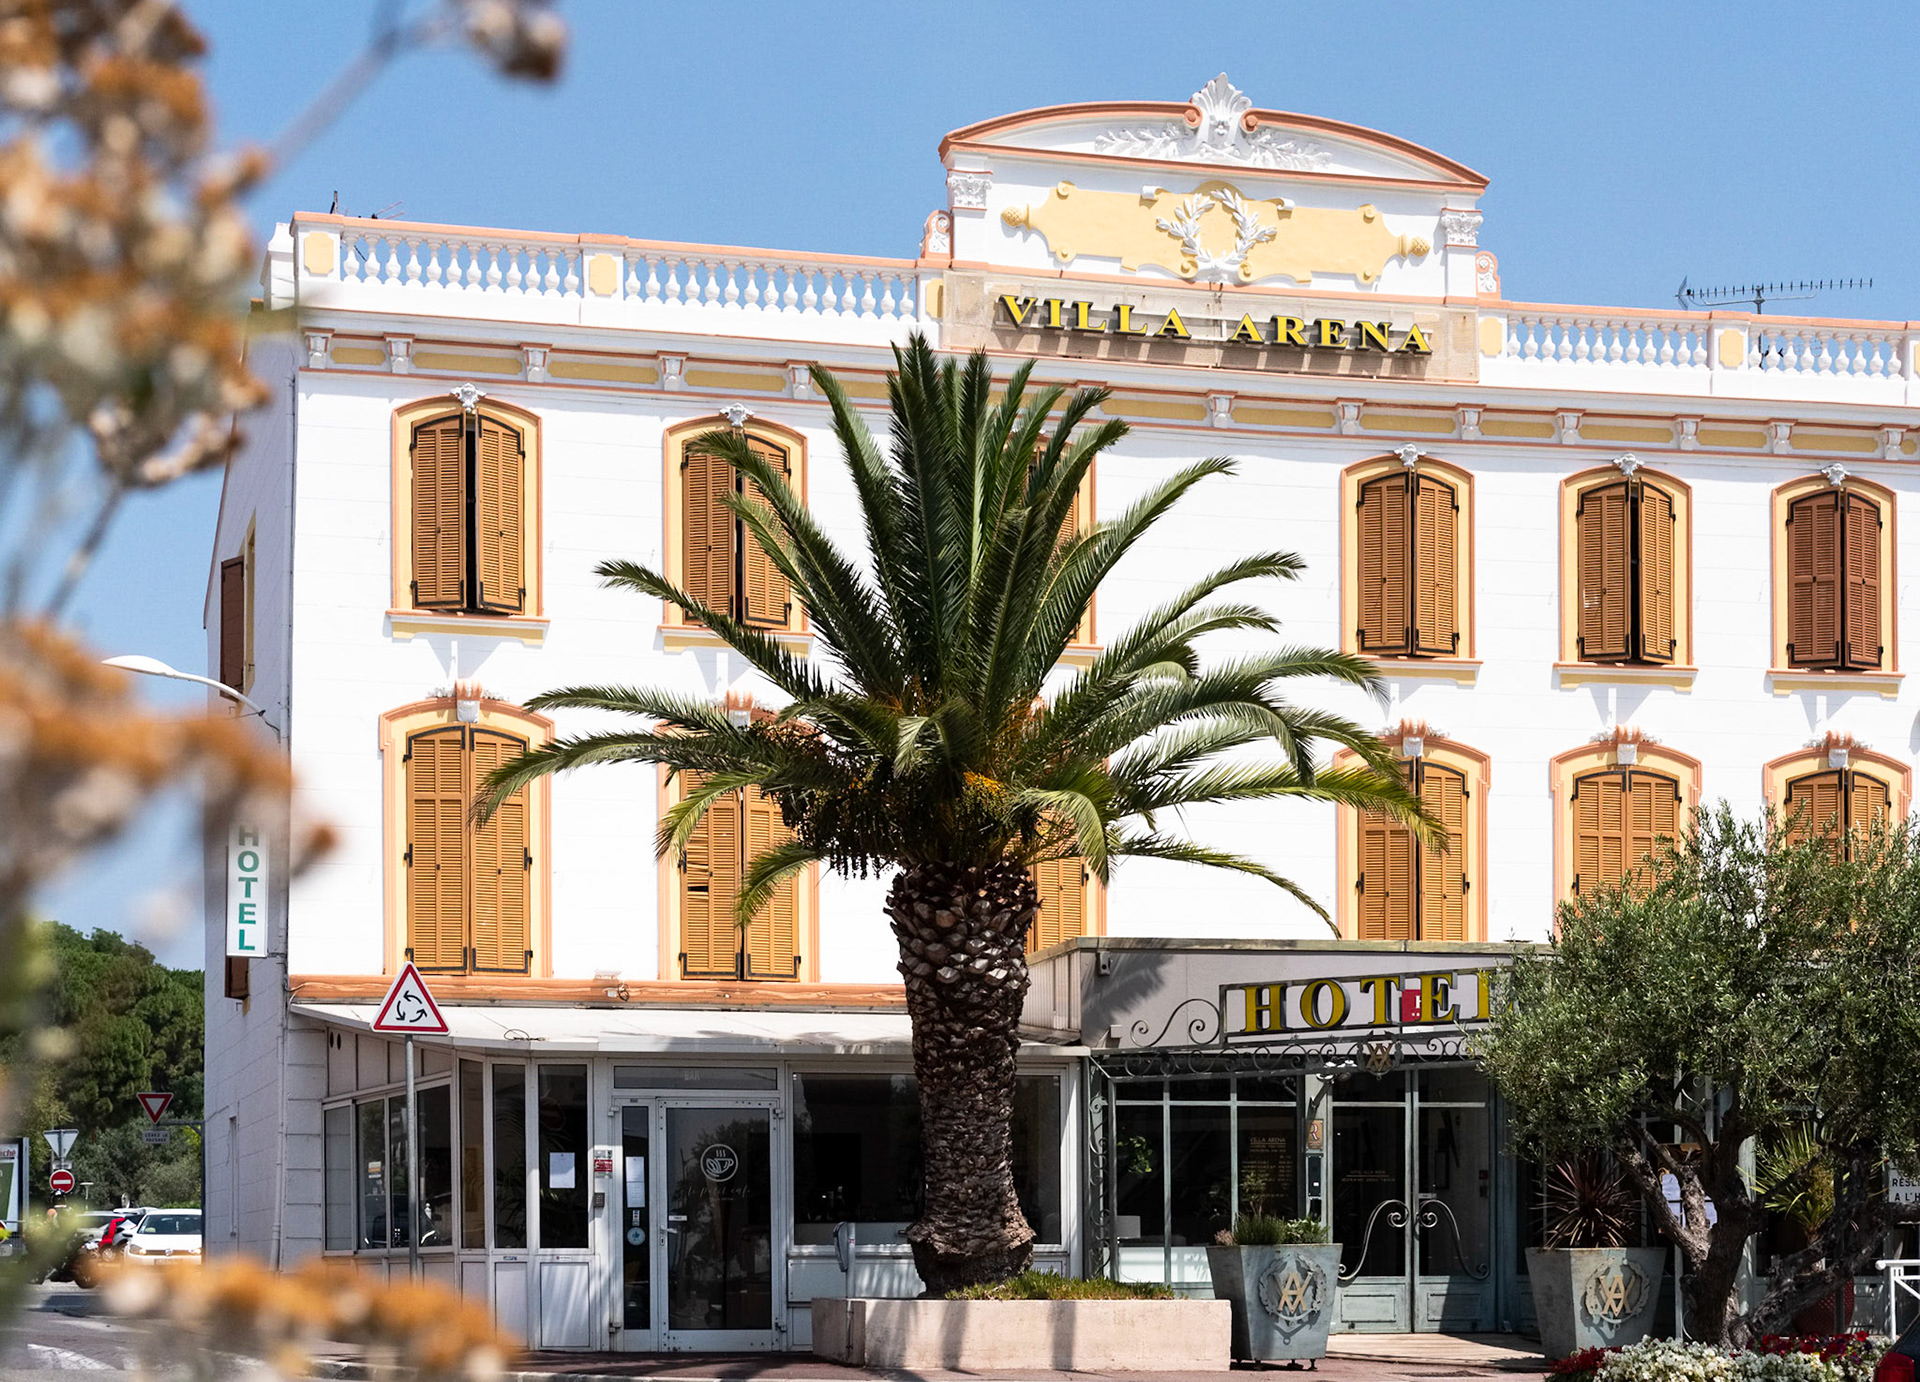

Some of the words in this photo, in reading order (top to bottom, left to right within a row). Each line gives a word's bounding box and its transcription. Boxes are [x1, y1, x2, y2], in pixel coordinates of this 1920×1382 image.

[999, 294, 1192, 339] VILLA
[1229, 313, 1432, 355] ARENA
[237, 824, 260, 951] HOTEL
[1895, 1192, 1900, 1201] A
